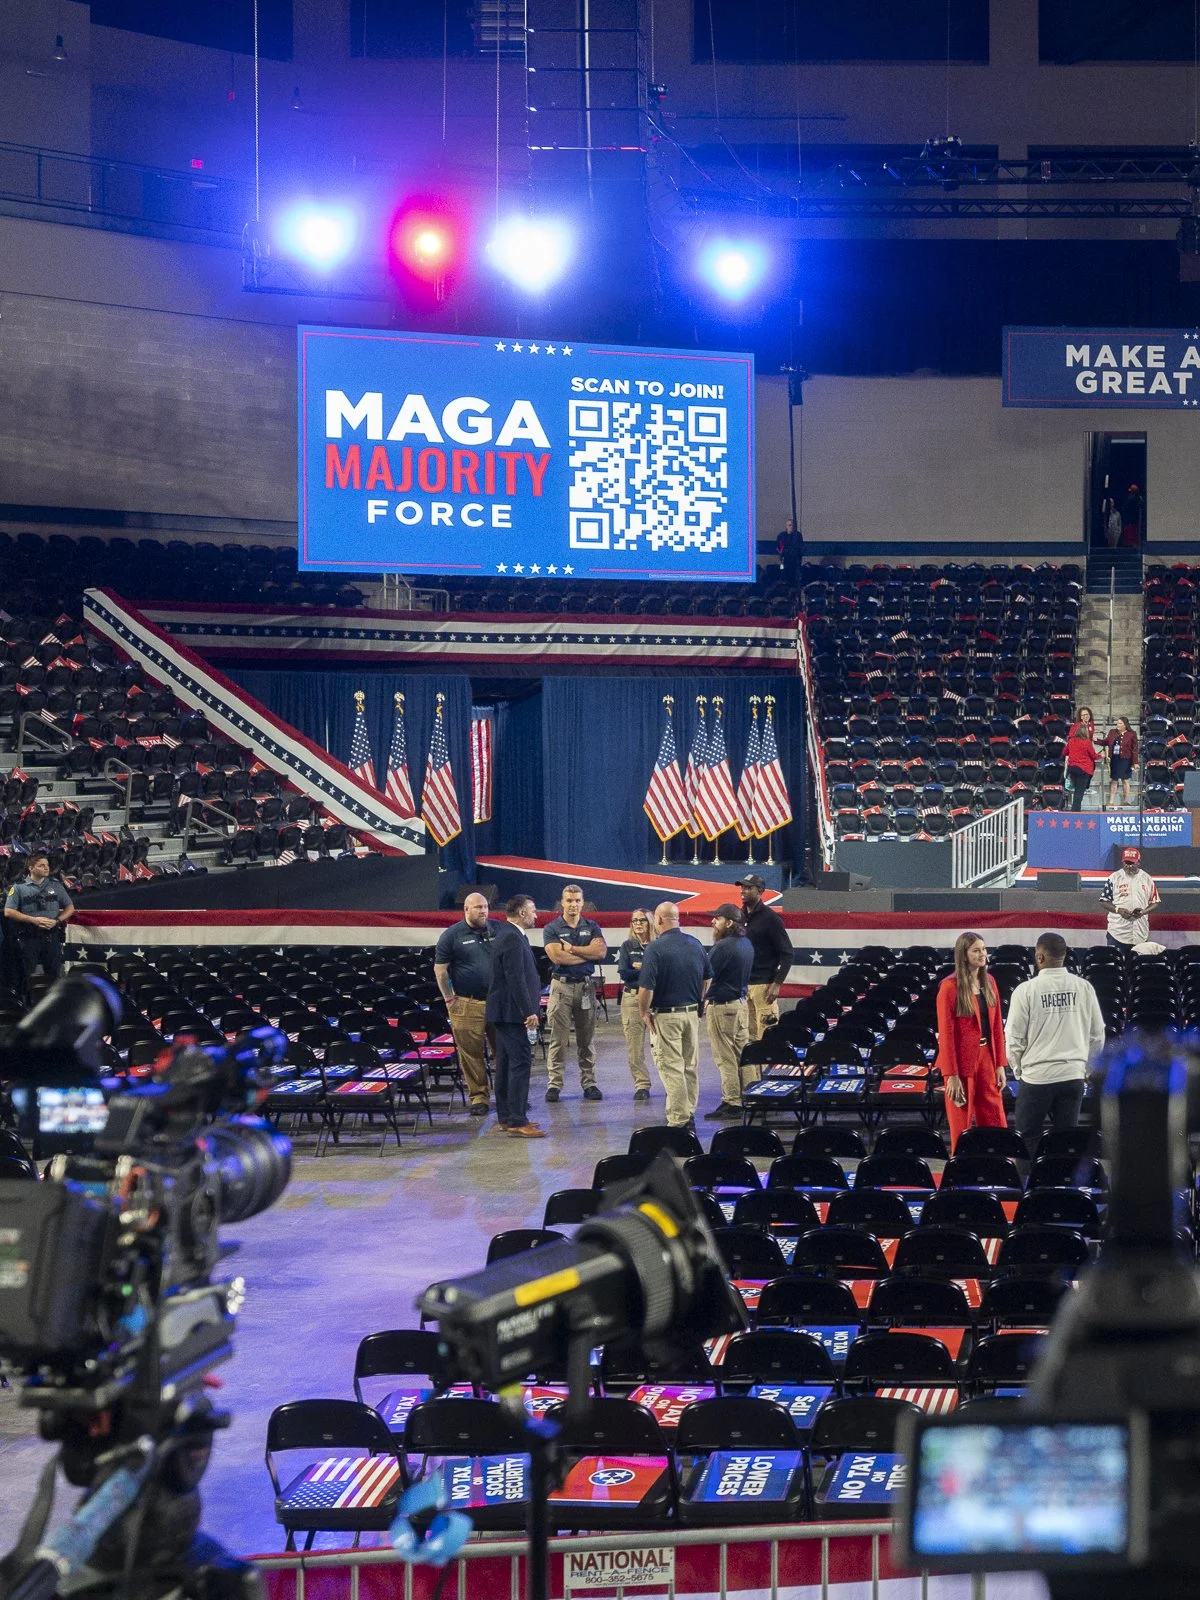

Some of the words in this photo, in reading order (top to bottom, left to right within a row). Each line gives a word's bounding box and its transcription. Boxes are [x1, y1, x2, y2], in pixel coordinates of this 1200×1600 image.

[1066, 344, 1166, 367] MAKE
[571, 376, 629, 395] SCAN
[636, 380, 665, 396] TO
[669, 382, 724, 399] JOIN!
[1075, 371, 1193, 394] GREAT
[325, 389, 551, 448] MAGA
[325, 443, 551, 496] MAJORITY
[368, 499, 512, 528] FORCE
[1107, 816, 1135, 824] MAKE
[1139, 816, 1184, 824] AMERICA
[1110, 824, 1141, 832] GREAT
[1146, 824, 1183, 832] AGAIN!
[1041, 992, 1077, 1008] HAGERTY
[833, 1331, 849, 1340] NO
[833, 1341, 849, 1355] TAX
[398, 1395, 417, 1411] TAX
[654, 1399, 671, 1409] ON
[677, 1388, 704, 1402] NO
[658, 1402, 688, 1424] TAX
[789, 1395, 816, 1417] TIPS
[389, 1411, 408, 1425] NO
[453, 1465, 472, 1485] TAX
[716, 1456, 744, 1496] PRICES
[740, 1455, 775, 1496] LOWER
[847, 1455, 877, 1479] TAX
[870, 1471, 887, 1483] ON
[472, 1476, 484, 1485] ON
[485, 1463, 505, 1497] SOCIAL
[505, 1457, 524, 1500] SECURITY
[884, 1464, 909, 1491] TIPS
[452, 1484, 470, 1500] NO
[838, 1480, 866, 1499] NO
[570, 1549, 670, 1571] NATIONAL
[570, 1566, 669, 1578] RENT-A-FENCE
[585, 1574, 654, 1584] 800-352-5675
